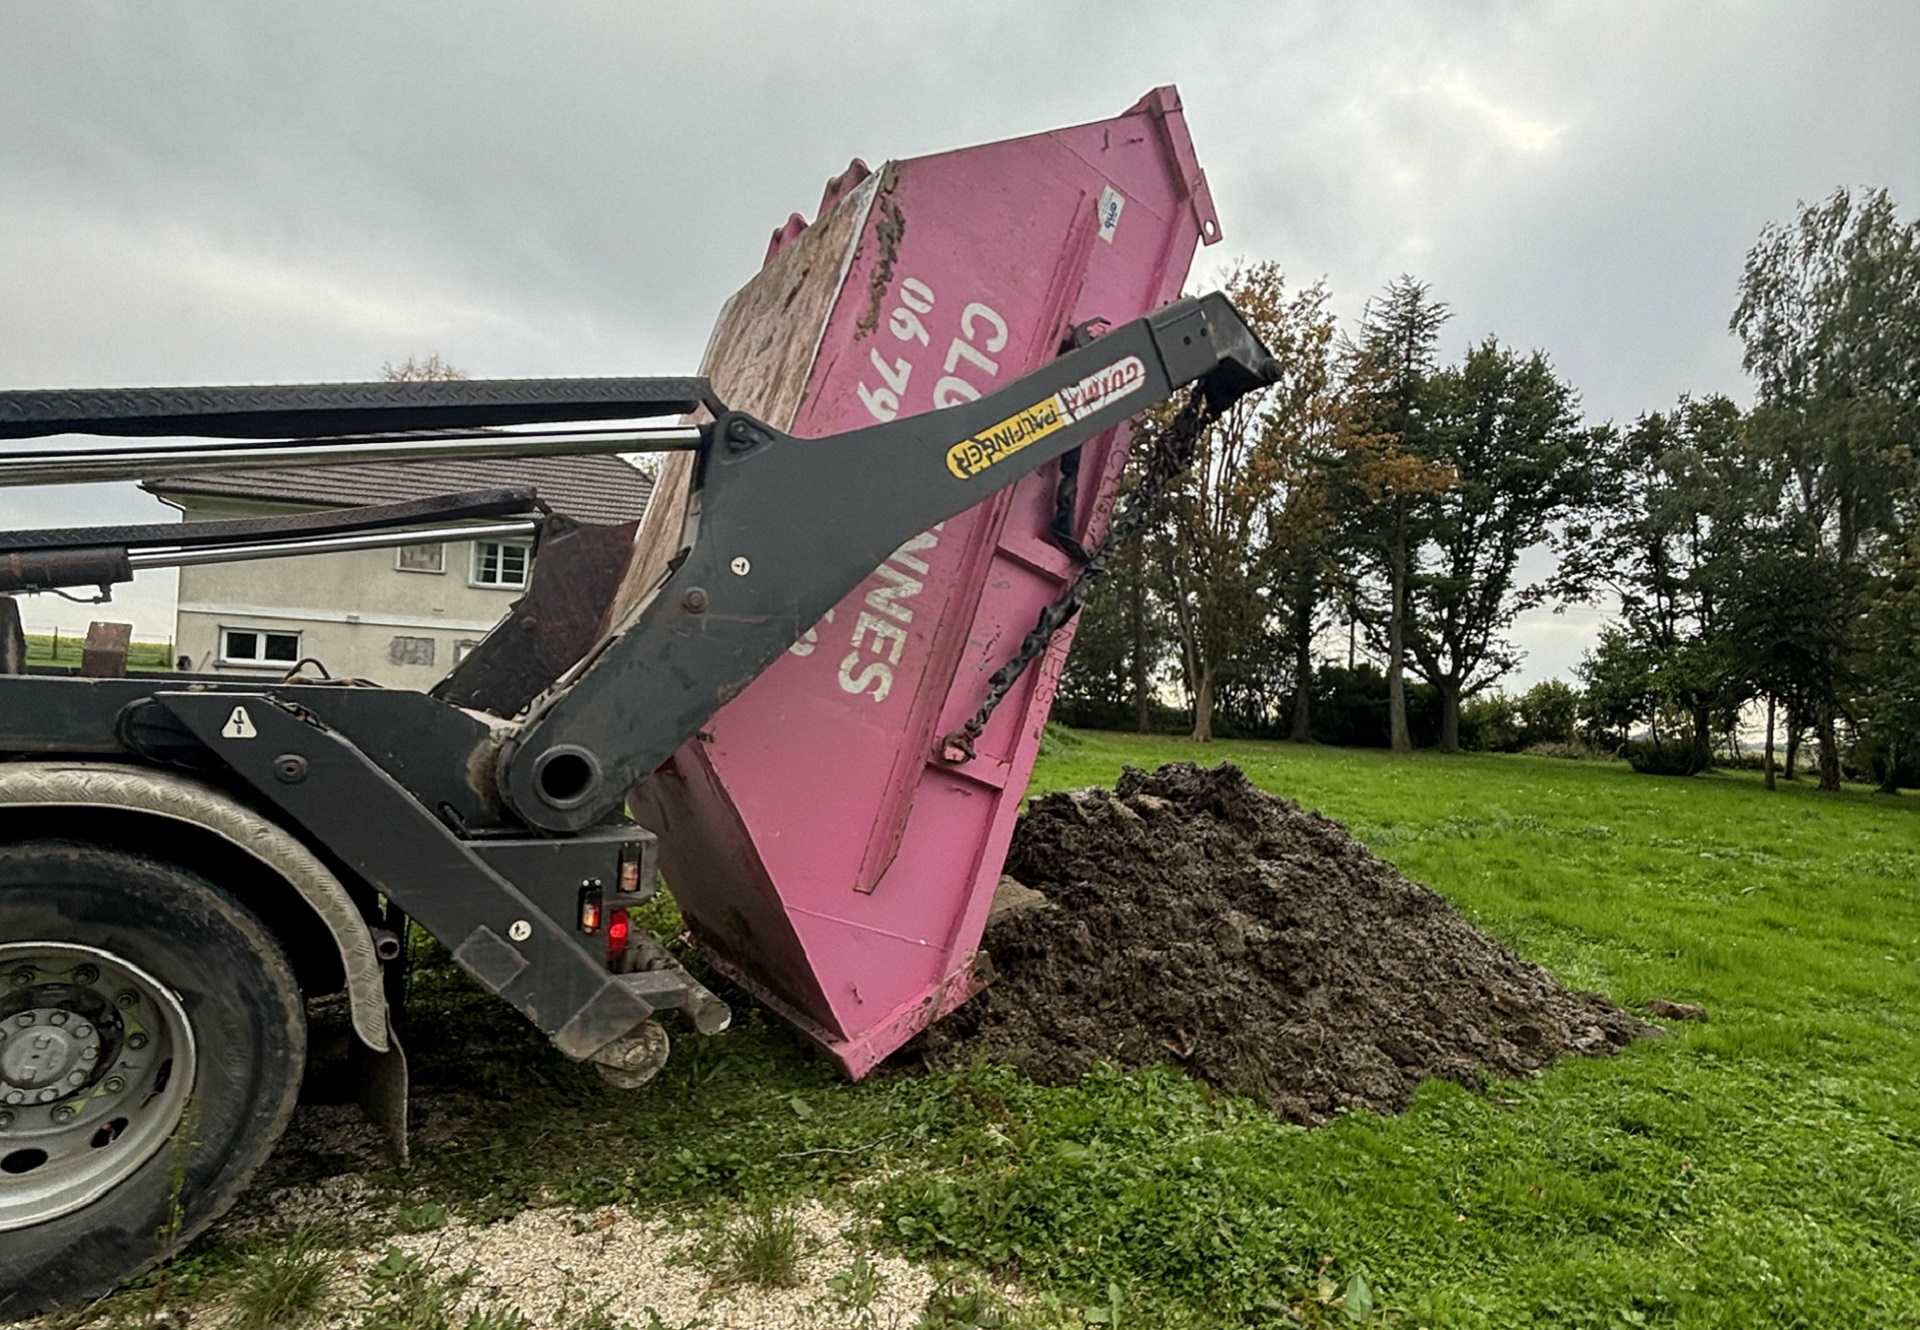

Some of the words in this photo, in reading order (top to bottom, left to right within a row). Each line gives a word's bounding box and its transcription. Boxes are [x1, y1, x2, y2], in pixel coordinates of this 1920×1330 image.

[889, 277, 935, 347] 06
[857, 347, 912, 422] 79
[952, 403, 1060, 473] PALFINGER
